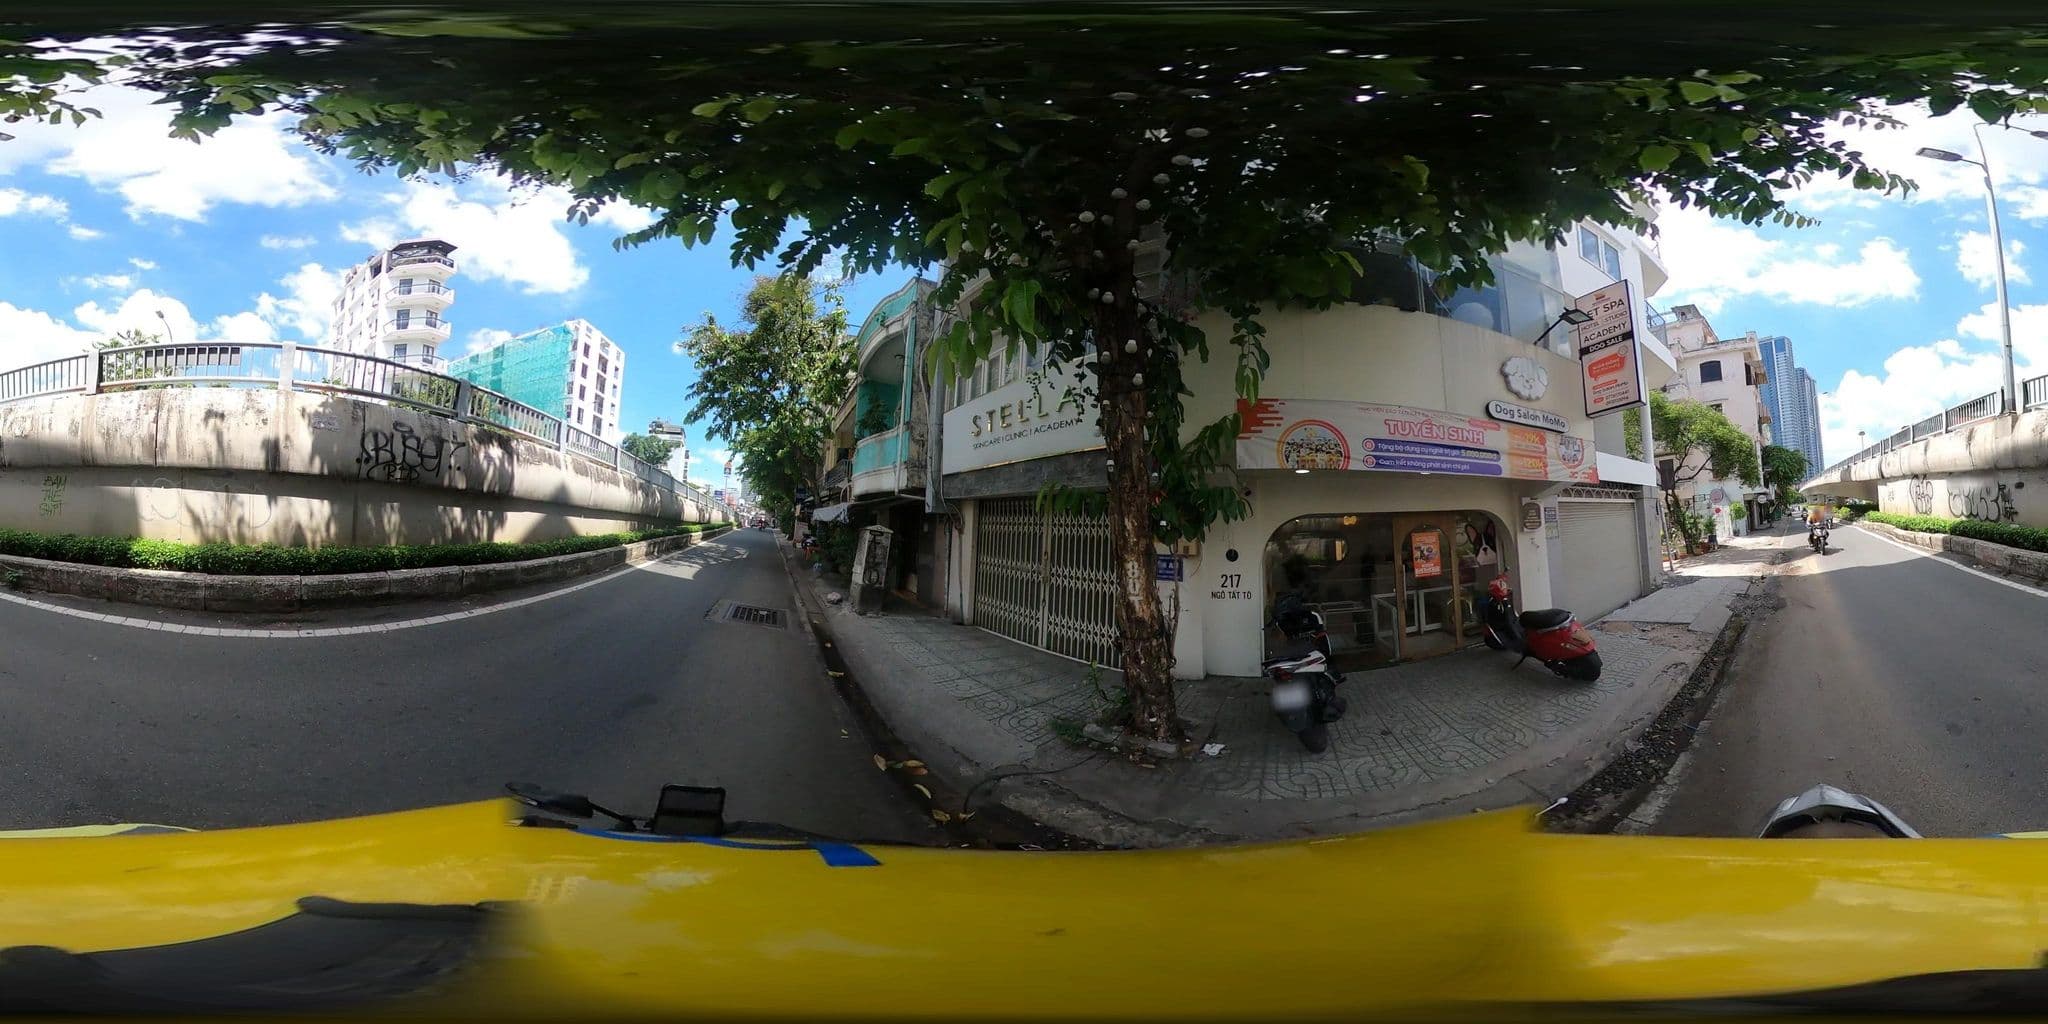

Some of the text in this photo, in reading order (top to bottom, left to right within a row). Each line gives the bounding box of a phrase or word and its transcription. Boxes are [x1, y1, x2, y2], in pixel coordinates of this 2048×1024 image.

[1602, 298, 1625, 313] SPA
[1604, 310, 1628, 323] STUDIO
[1583, 320, 1628, 344] ACADEMY
[1589, 335, 1624, 353] DOG SALE
[970, 385, 1080, 438] STELLA
[1494, 403, 1566, 429] Dog Salon MoMo
[1033, 417, 1083, 435] ACADEMY
[1447, 425, 1485, 446] SINH
[1220, 573, 1241, 588] 217
[1211, 590, 1226, 600] NGÔ
